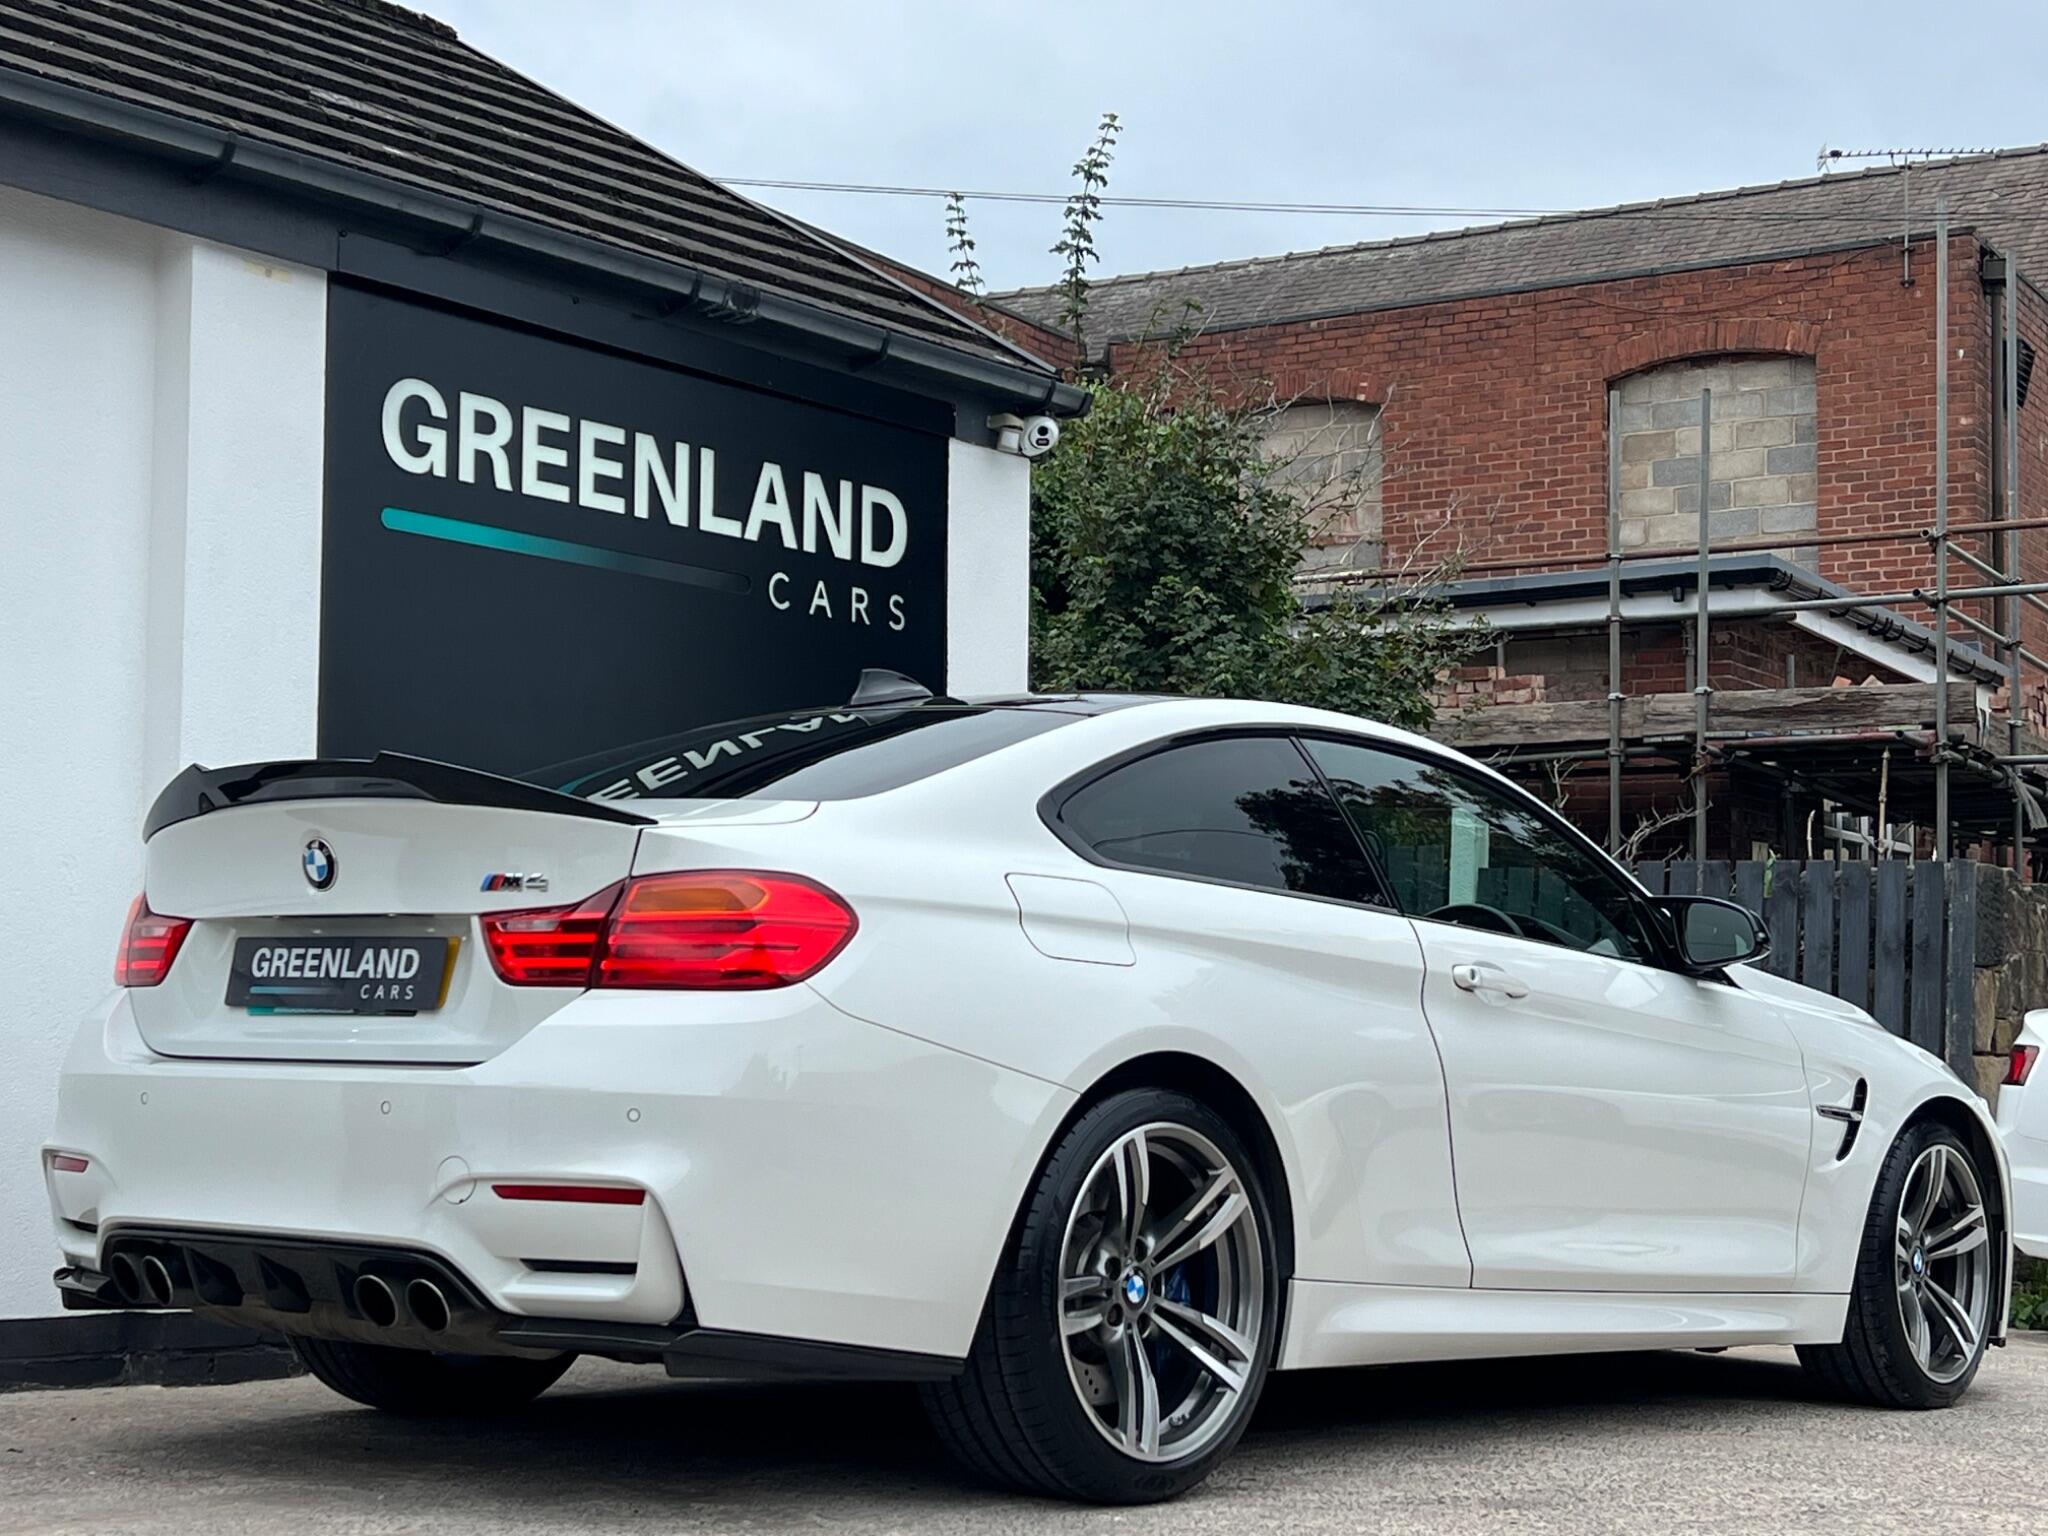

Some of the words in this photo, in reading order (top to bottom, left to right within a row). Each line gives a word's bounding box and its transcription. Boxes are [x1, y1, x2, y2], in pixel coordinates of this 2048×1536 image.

[381, 377, 908, 568] GREENLAND
[768, 572, 906, 630] CARS
[251, 947, 420, 979] GREENLAND
[360, 984, 414, 1000] CARS
